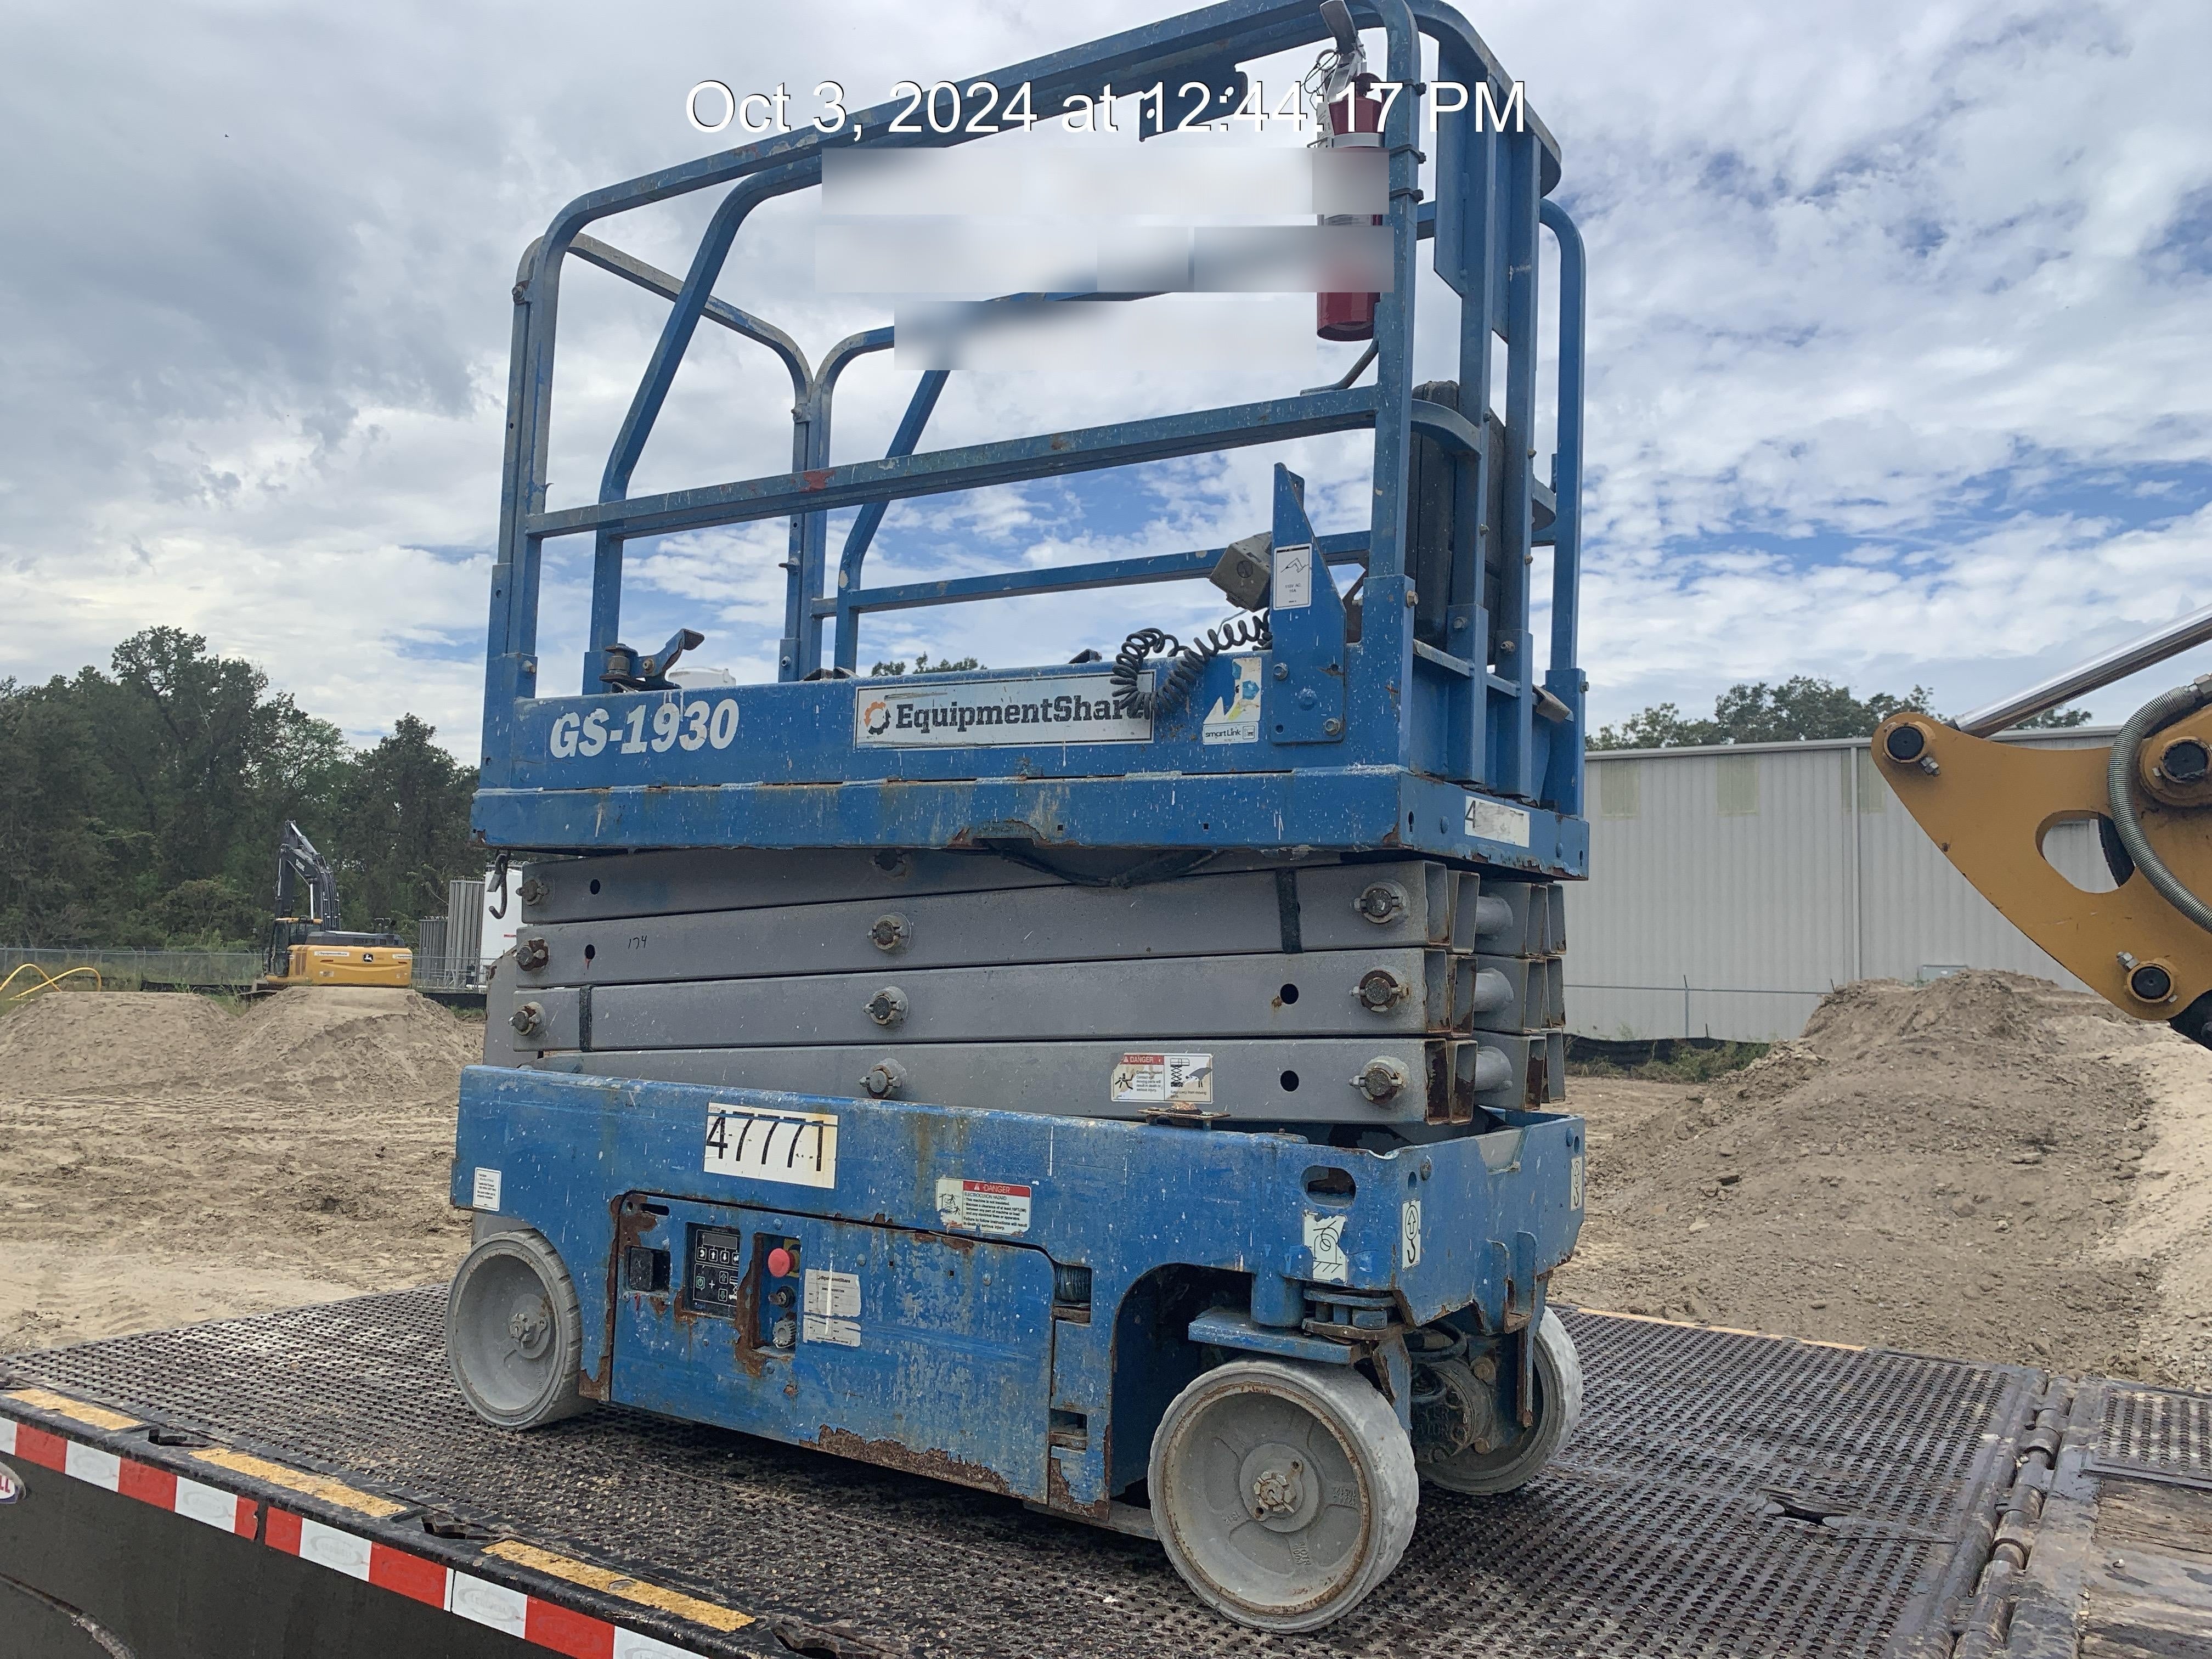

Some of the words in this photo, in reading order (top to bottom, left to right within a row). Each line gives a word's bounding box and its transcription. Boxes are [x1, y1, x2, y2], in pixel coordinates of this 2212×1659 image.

[550, 698, 739, 758] GS-1930
[706, 1109, 824, 1172] 47771
[984, 1183, 1010, 1194] DANGER
